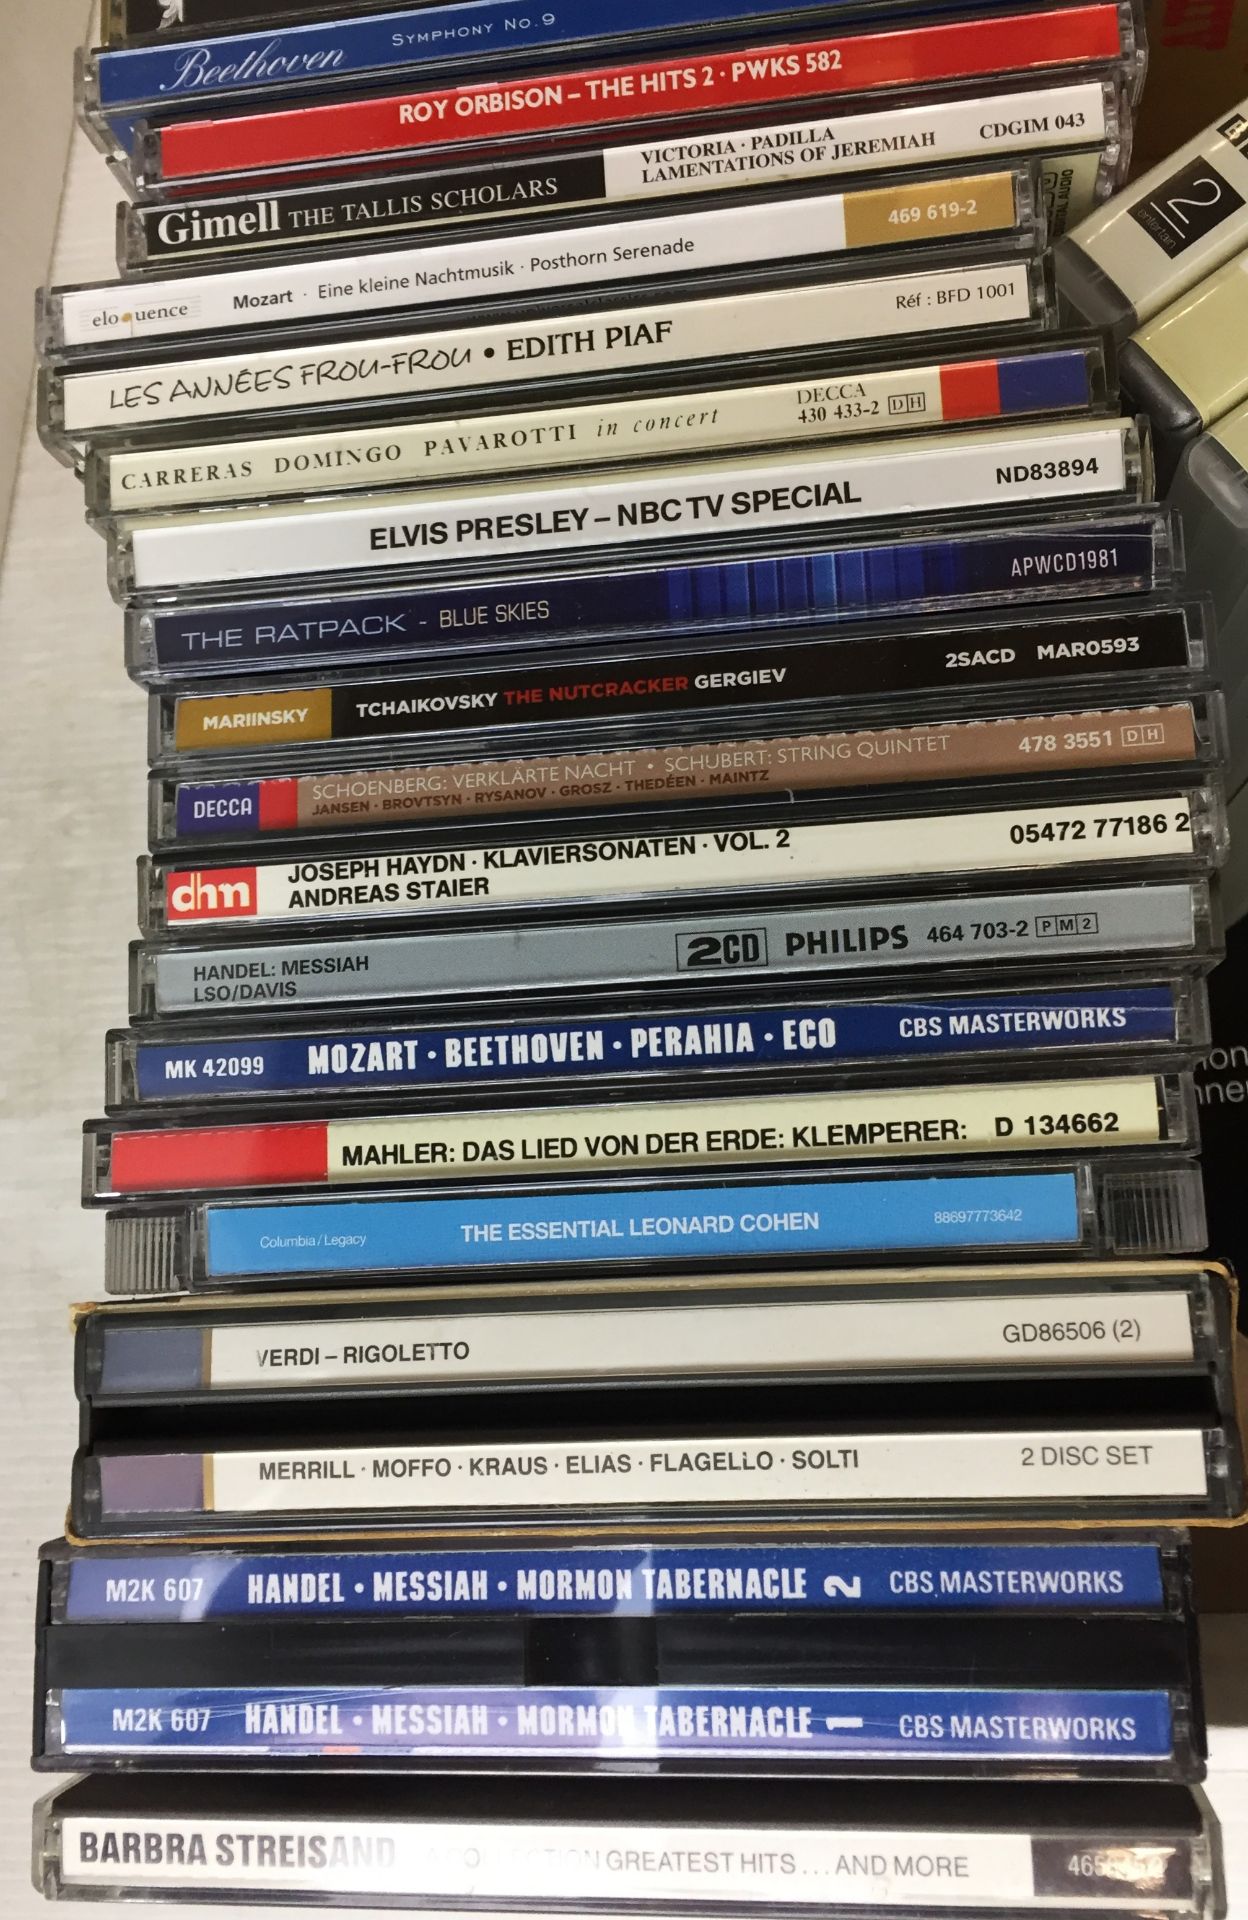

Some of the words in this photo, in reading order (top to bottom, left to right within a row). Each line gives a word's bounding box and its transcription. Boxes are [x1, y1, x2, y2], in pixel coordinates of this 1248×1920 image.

[159, 38, 345, 92] Beethoven
[399, 98, 447, 124] ROY
[455, 86, 564, 117] ORBISON
[585, 76, 634, 101] THE
[640, 69, 697, 95] HITS
[702, 68, 714, 86] 2
[732, 57, 800, 82] PWKS
[805, 49, 842, 74] 582
[980, 117, 1049, 140] CDGIM
[1054, 112, 1085, 131] 043
[640, 138, 737, 165] VICTORIA
[751, 127, 836, 151] PADILLA
[641, 148, 794, 184] LAMENTATIONS
[798, 145, 827, 162] OF
[831, 131, 936, 161] JEREMIAH
[157, 201, 279, 246] Gimell
[288, 208, 334, 228] THE
[342, 198, 423, 222] TALLIS
[431, 178, 558, 211] SCHOLARS
[888, 203, 921, 225] 469
[927, 200, 977, 221] 619-2
[1167, 178, 1221, 224] 2
[233, 290, 293, 312] Mozart
[318, 284, 354, 300] Eine
[359, 277, 409, 297] kleine
[415, 262, 515, 291] Nachtmusik
[530, 249, 606, 272] Posthorn
[613, 238, 695, 264] Serenade
[936, 287, 972, 306] BFD
[976, 282, 1015, 301] 1001
[109, 382, 160, 409] LES
[169, 365, 294, 401] ANNÉES
[300, 346, 472, 387] FROU-FROU
[507, 329, 595, 361] EDITH
[606, 320, 673, 350] PIAF
[797, 383, 866, 405] DECCA
[797, 406, 827, 424] 430
[833, 400, 880, 420] 433-2
[121, 461, 253, 490] CARRERAS
[275, 442, 402, 474] DOMINGO
[424, 424, 578, 457] PAVAROTTI
[597, 418, 618, 437] in
[634, 406, 718, 434] concert
[996, 457, 1099, 484] ND83894
[370, 521, 450, 551] ELVIS
[454, 509, 590, 542] PRESLEY
[617, 497, 683, 527] NBC
[686, 495, 729, 520] TV
[731, 481, 862, 516] SPECIAL
[1011, 548, 1118, 576] APWCD1981
[181, 627, 244, 651] THE
[256, 613, 406, 645] RATPACK
[439, 606, 489, 629] BLUE
[495, 600, 550, 623] SKIES
[945, 647, 1016, 669] 2SACD
[356, 692, 498, 719] TCHAIKOVSKY
[504, 689, 544, 705] THE
[549, 676, 688, 703] NUTCRACKER
[694, 667, 787, 690] GERGIEV
[202, 708, 308, 731] MARIINSKY
[1019, 734, 1057, 754] 478
[1063, 730, 1113, 749] 3551
[312, 774, 446, 800] SCHOENBERG:
[452, 761, 560, 790] VERKLÄRTE
[565, 759, 635, 780] NACHT
[665, 749, 773, 772] SCHUBERT:
[778, 742, 852, 764] STRING
[857, 735, 951, 758] QUINTET
[194, 798, 252, 820] DECCA
[312, 800, 370, 816] JANSEN
[382, 794, 462, 810] BROVTSYN
[475, 787, 547, 804] RYSANOV
[559, 782, 613, 798] GROSZ
[709, 770, 769, 785] MAINTZ
[1010, 820, 1087, 844] 05472
[1094, 815, 1168, 840] 77186
[1175, 812, 1190, 832] 2
[288, 859, 380, 884] JOSEPH
[386, 854, 465, 877] HAYDN
[482, 836, 696, 869] KLAVIERSONATEN
[714, 831, 771, 852] VOL.
[776, 829, 790, 848] 2
[172, 873, 250, 913] dhm
[288, 883, 399, 909] ANDREAS
[406, 877, 489, 900] STAIER
[687, 934, 760, 967] 2CD
[786, 925, 908, 956] PHILIPS
[927, 924, 964, 944] 464
[970, 921, 1029, 940] 703-2
[193, 964, 276, 981] HANDEL:
[281, 956, 369, 975] MESSIAH
[194, 981, 297, 1003] LSO/DAVIS
[899, 1016, 942, 1038] CBS
[949, 1006, 1127, 1035] MASTERWORKS
[165, 1060, 197, 1079] MK
[202, 1056, 264, 1077] 42099
[308, 1040, 419, 1074] MOZART
[446, 1031, 603, 1068] BEETHOVEN
[632, 1022, 754, 1058] PERAHIA
[783, 1018, 836, 1050] ECO
[995, 1116, 1013, 1136] D
[1024, 1112, 1119, 1135] 134662
[342, 1142, 455, 1167] MAHLER:
[463, 1139, 514, 1162] DAS
[521, 1136, 578, 1160] LIED
[585, 1134, 639, 1157] VON
[646, 1131, 699, 1154] DER
[705, 1127, 785, 1151] ERDE:
[792, 1119, 967, 1148] KLEMPERER:
[461, 1225, 504, 1242] THE
[507, 1220, 623, 1240] ESSENTIAL
[630, 1214, 733, 1236] LEONARD
[739, 1211, 820, 1232] COHEN
[1003, 1321, 1106, 1344] GD86506
[257, 1349, 319, 1368] VERDI
[343, 1341, 470, 1364] RIGOLETTO
[259, 1461, 354, 1480] MERRILL
[372, 1459, 451, 1478] MOFFO
[469, 1457, 548, 1477] KRAUS
[566, 1455, 631, 1475] ELIAS
[649, 1451, 773, 1473] FLAGELLO
[792, 1449, 858, 1469] SOLTI
[1021, 1448, 1034, 1466] 2
[1041, 1446, 1099, 1466] DISC
[1106, 1446, 1153, 1465] SET
[106, 1579, 155, 1602] M2K
[163, 1577, 204, 1602] 607
[248, 1573, 344, 1603] HANDEL
[373, 1571, 488, 1600] MESSIAH
[516, 1569, 632, 1600] MORMON
[642, 1568, 807, 1600] TABERNACLE
[889, 1571, 933, 1594] CBS
[939, 1570, 1123, 1594] MASTERWORKS
[112, 1709, 163, 1732] M2K
[245, 1706, 343, 1735] HANDEL
[372, 1705, 488, 1735] MESSIAH
[517, 1705, 633, 1736] MORMON
[642, 1706, 812, 1738] TABERNACLE
[899, 1715, 944, 1739] CBS
[950, 1716, 1136, 1741] MASTERWORKS
[80, 1832, 207, 1868] BARBRA
[215, 1834, 395, 1870] STREISAND
[606, 1850, 734, 1875] GREATEST
[835, 1853, 887, 1877] AND
[892, 1854, 969, 1878] MORE
